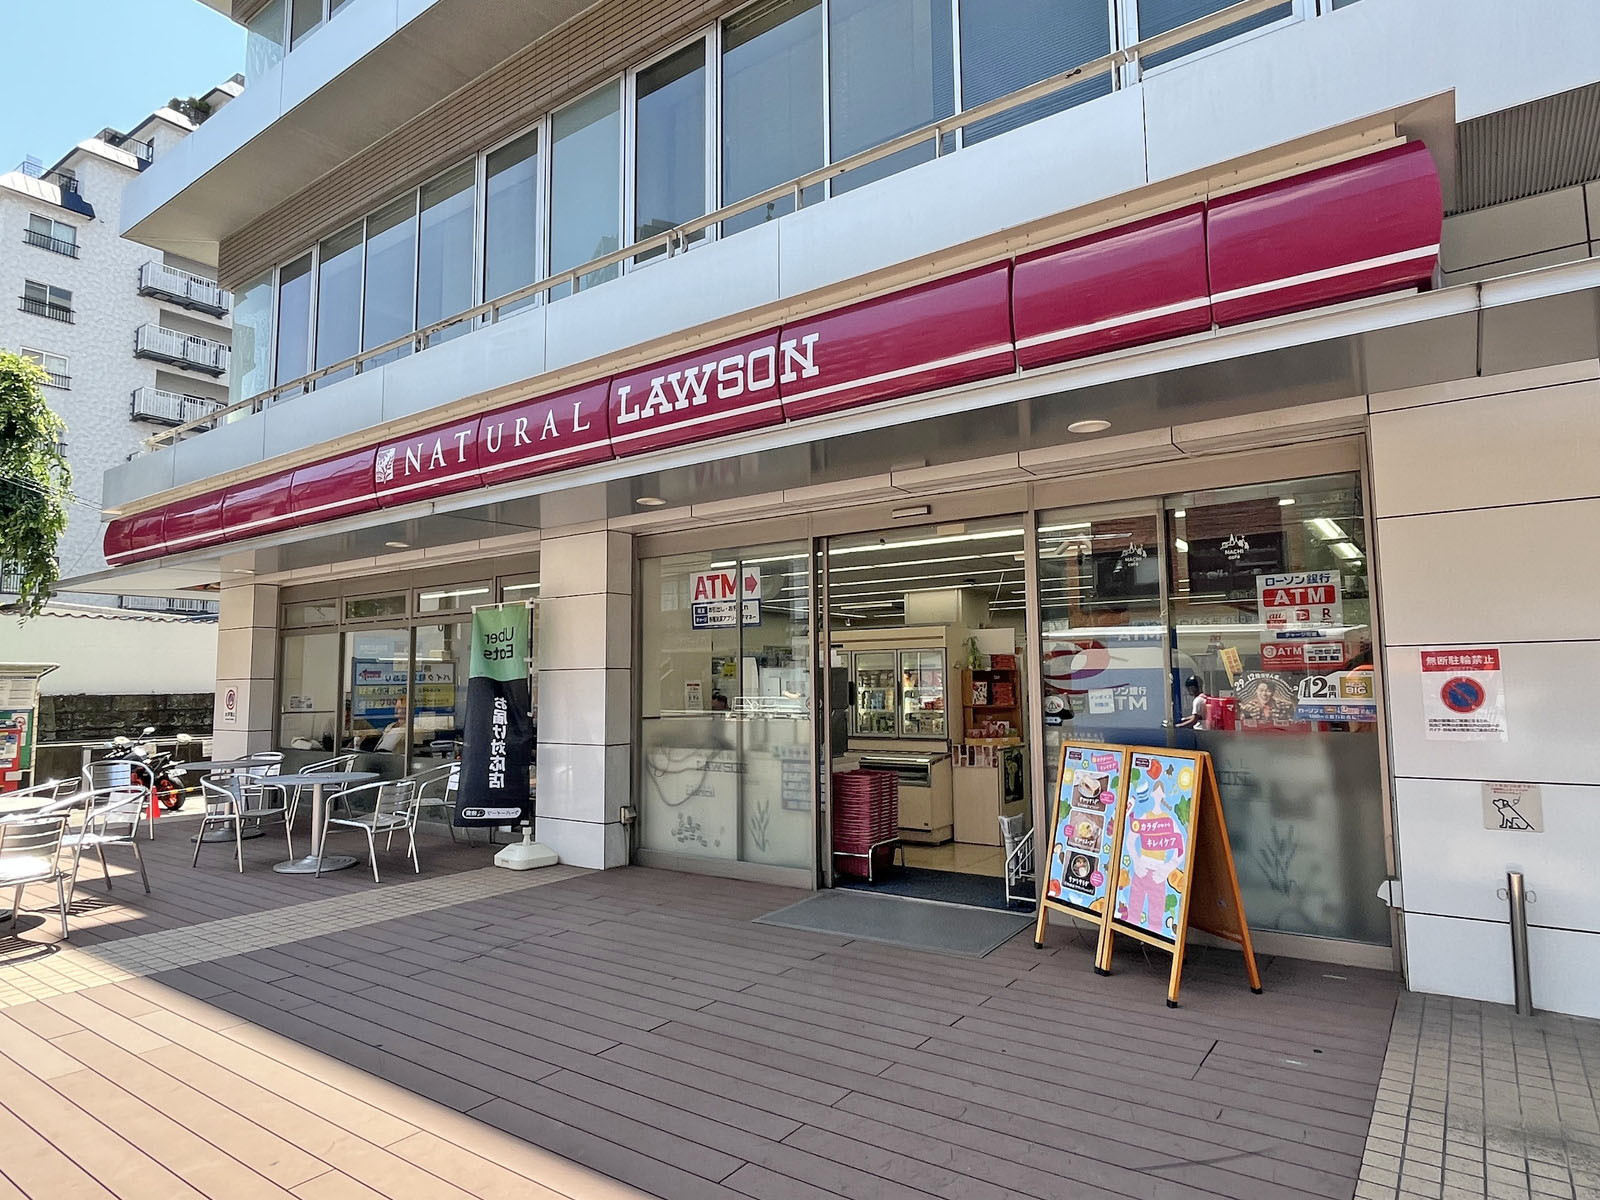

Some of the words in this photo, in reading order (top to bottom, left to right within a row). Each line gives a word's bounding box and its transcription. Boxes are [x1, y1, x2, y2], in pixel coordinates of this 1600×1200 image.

[403, 402, 590, 476] NATURAL
[616, 332, 820, 425] LAWSON
[1265, 573, 1331, 587] ローソン銀行
[694, 573, 737, 601] ATM
[1274, 587, 1326, 606] ATM
[1277, 646, 1302, 655] ATM
[1425, 654, 1496, 667] 無断駐輪禁止
[1113, 687, 1148, 696] ソン銀行
[1345, 687, 1368, 695] BIG
[1114, 696, 1148, 711] TM
[1146, 837, 1176, 848] キレイケア
